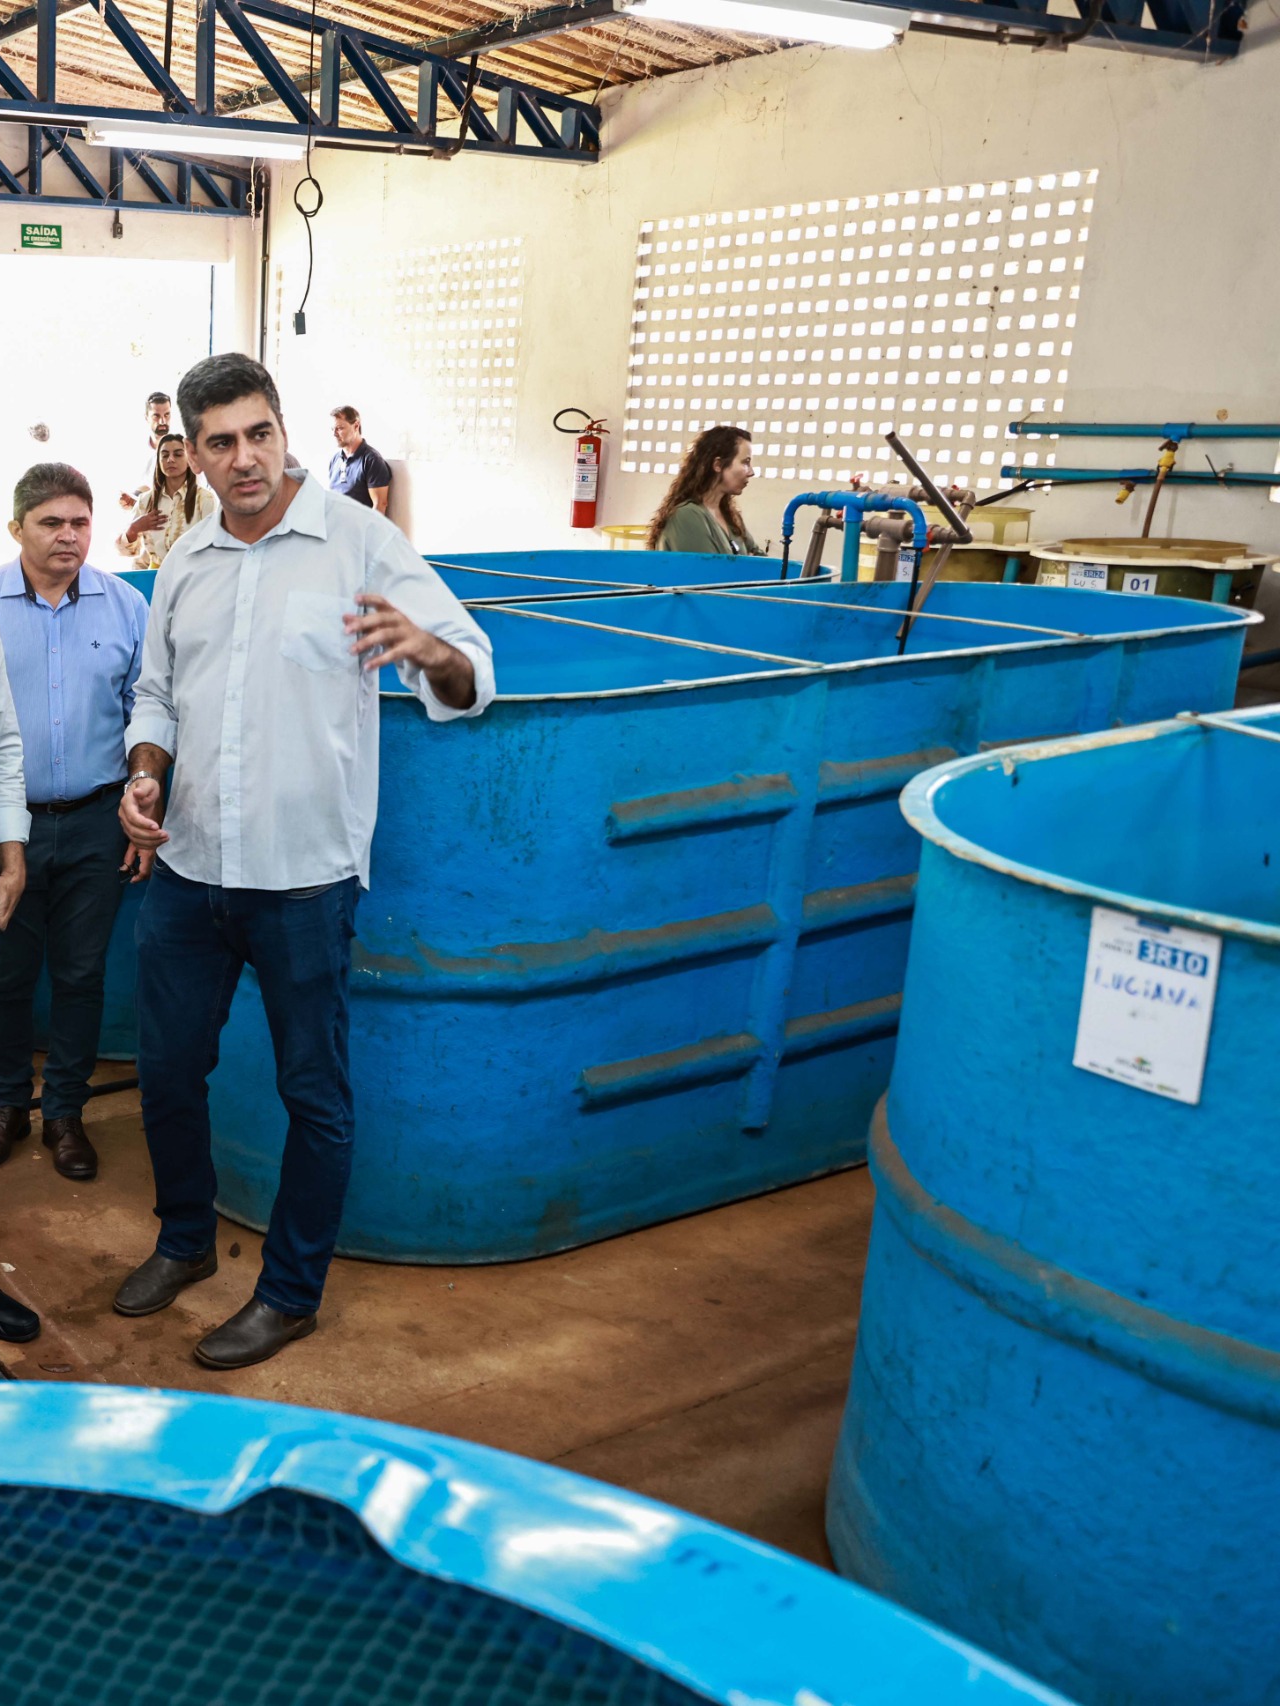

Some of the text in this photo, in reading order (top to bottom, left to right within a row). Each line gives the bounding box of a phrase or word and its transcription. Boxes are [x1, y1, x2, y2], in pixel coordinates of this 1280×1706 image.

[26, 225, 58, 236] SAÍDA
[1130, 578, 1150, 592] 01
[1142, 941, 1205, 977] 3R10
